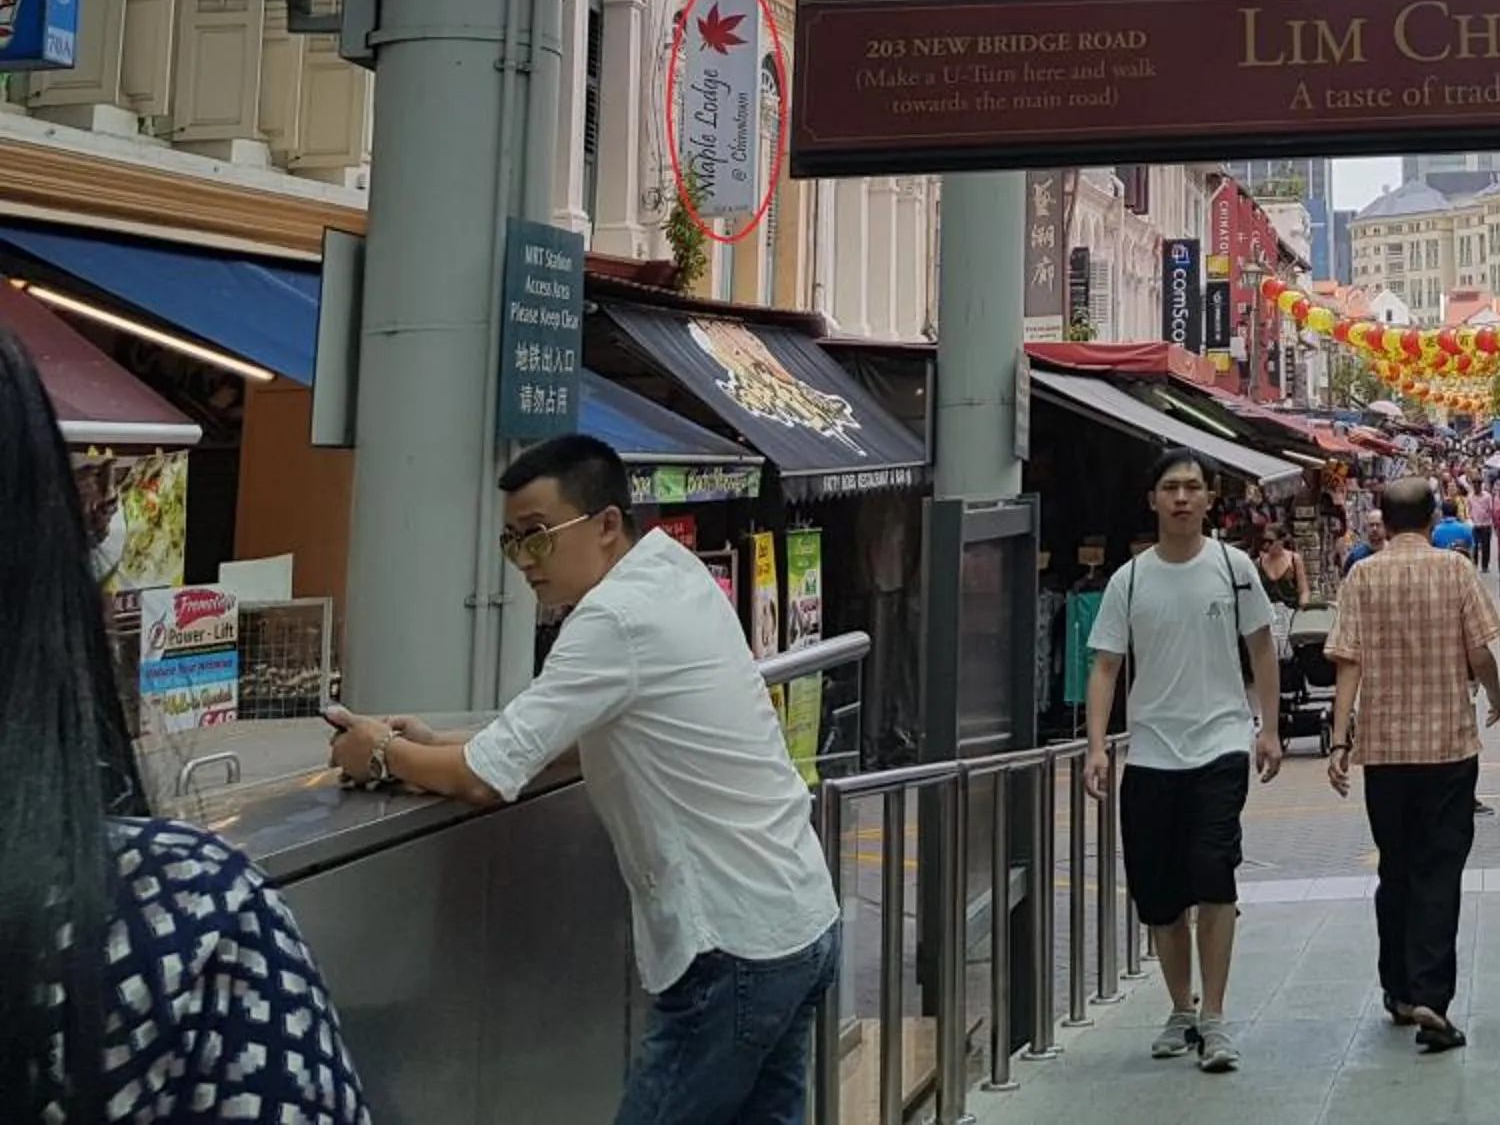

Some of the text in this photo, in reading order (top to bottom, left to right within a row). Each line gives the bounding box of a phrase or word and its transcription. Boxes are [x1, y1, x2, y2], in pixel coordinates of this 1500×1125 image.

[913, 35, 973, 58] NEW
[977, 32, 1072, 56] BRIDGE
[1078, 29, 1148, 51] ROAD
[855, 68, 921, 92] (Make
[925, 72, 937, 87] a
[1022, 62, 1066, 83] here
[1071, 61, 1107, 82] and
[1111, 57, 1158, 79] walk
[892, 84, 1120, 115] towards the main road)
[1289, 82, 1314, 111] A
[1325, 83, 1393, 110] taste
[1402, 75, 1440, 108] of
[689, 68, 732, 198] Maple Lodge
[731, 164, 748, 183] @
[524, 244, 573, 273] MRT Station
[524, 275, 571, 302] Access Area
[510, 302, 579, 331] Please Keep Clear
[1171, 268, 1188, 342] comSco
[168, 628, 205, 645] Power
[214, 622, 234, 640] Lift
